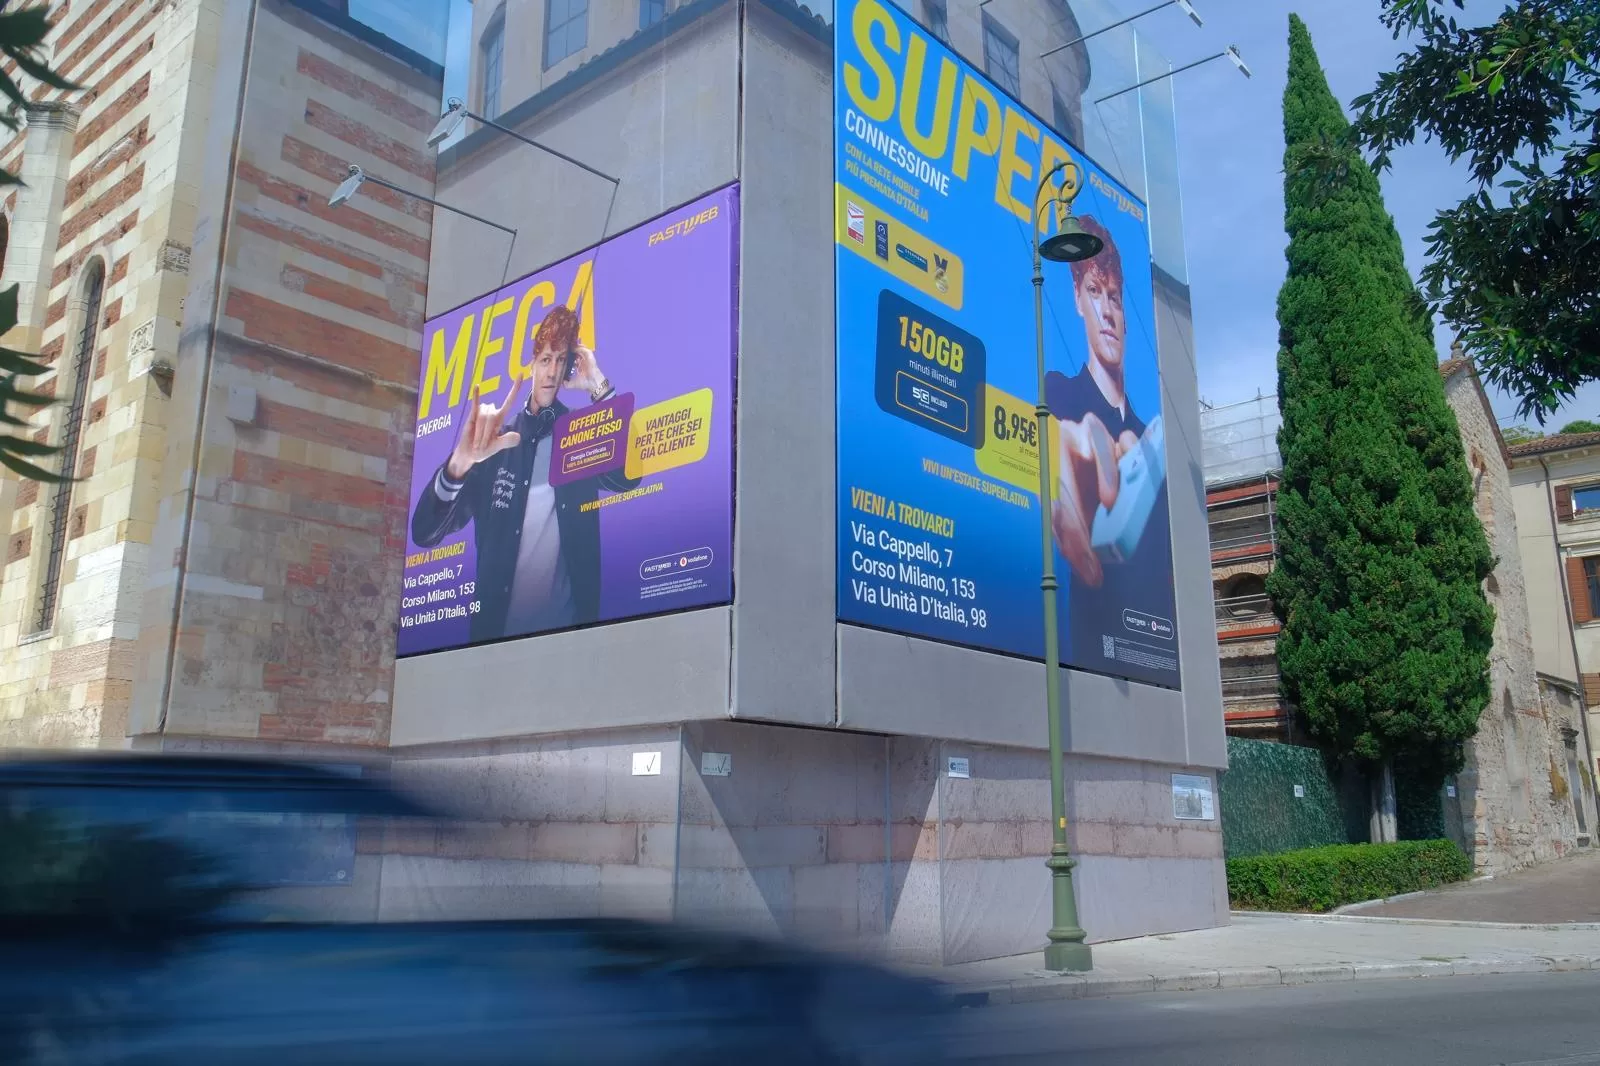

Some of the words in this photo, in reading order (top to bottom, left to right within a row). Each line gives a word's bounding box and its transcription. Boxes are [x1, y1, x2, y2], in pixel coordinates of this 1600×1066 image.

[843, 0, 1077, 235] SUPER
[845, 109, 950, 197] CONNESSIONE
[845, 142, 861, 161] CON
[862, 153, 873, 167] LA
[874, 160, 892, 182] RETE
[892, 174, 920, 199] MOBILE
[845, 159, 859, 177] PIÙ
[860, 169, 896, 201] PREMIATA
[897, 191, 929, 222] D'ITALIA
[1089, 171, 1144, 222] FASTWEB
[648, 205, 719, 247] FASTWEB
[418, 259, 596, 419] MEGA
[898, 315, 964, 374] 150GB
[909, 359, 931, 376] minuti
[931, 368, 957, 389] illimitati
[912, 386, 930, 405] 5G
[416, 413, 452, 439] ENERGIA
[560, 429, 596, 449] CANONE
[596, 419, 622, 438] FISSO
[569, 410, 607, 433] OFFERTE
[606, 408, 613, 420] A
[635, 435, 652, 449] PER
[653, 431, 667, 445] TE
[667, 426, 685, 440] CHE
[686, 418, 702, 434] SEI
[646, 408, 692, 433] VANTAGGI
[993, 404, 1037, 448] 8,95€
[640, 440, 656, 461] GIÀ
[657, 434, 696, 457] CLIENTE
[580, 502, 593, 513] VIVI
[623, 482, 663, 502] SUPERLATIVA
[922, 457, 939, 476] VIVI
[940, 464, 981, 491] UN'ESTATE
[981, 480, 1030, 510] SUPERLATIVA
[851, 486, 886, 517] VIENI
[885, 500, 896, 520] A
[898, 502, 954, 538] TROVARCI
[405, 552, 424, 568] VIENI
[423, 551, 430, 563] A
[430, 541, 466, 561] TROVARCI
[851, 521, 876, 547] Via
[879, 530, 942, 568] Cappello,
[944, 548, 953, 568] 7
[402, 595, 426, 609] Corso
[427, 588, 456, 604] Milano,
[459, 581, 476, 596] 153
[404, 576, 417, 589] Via
[418, 567, 455, 586] Cappello,
[456, 564, 463, 577] 7
[852, 550, 896, 580] Corso
[899, 562, 949, 597] Milano,
[951, 577, 976, 600] 153
[400, 616, 414, 628] Via
[415, 609, 436, 625] Unità
[437, 604, 467, 621] D'Italia,
[469, 600, 481, 614] 98
[851, 578, 877, 604] Via
[880, 585, 917, 613] Unità
[920, 595, 969, 628] D'Italia,
[970, 607, 987, 628] 98
